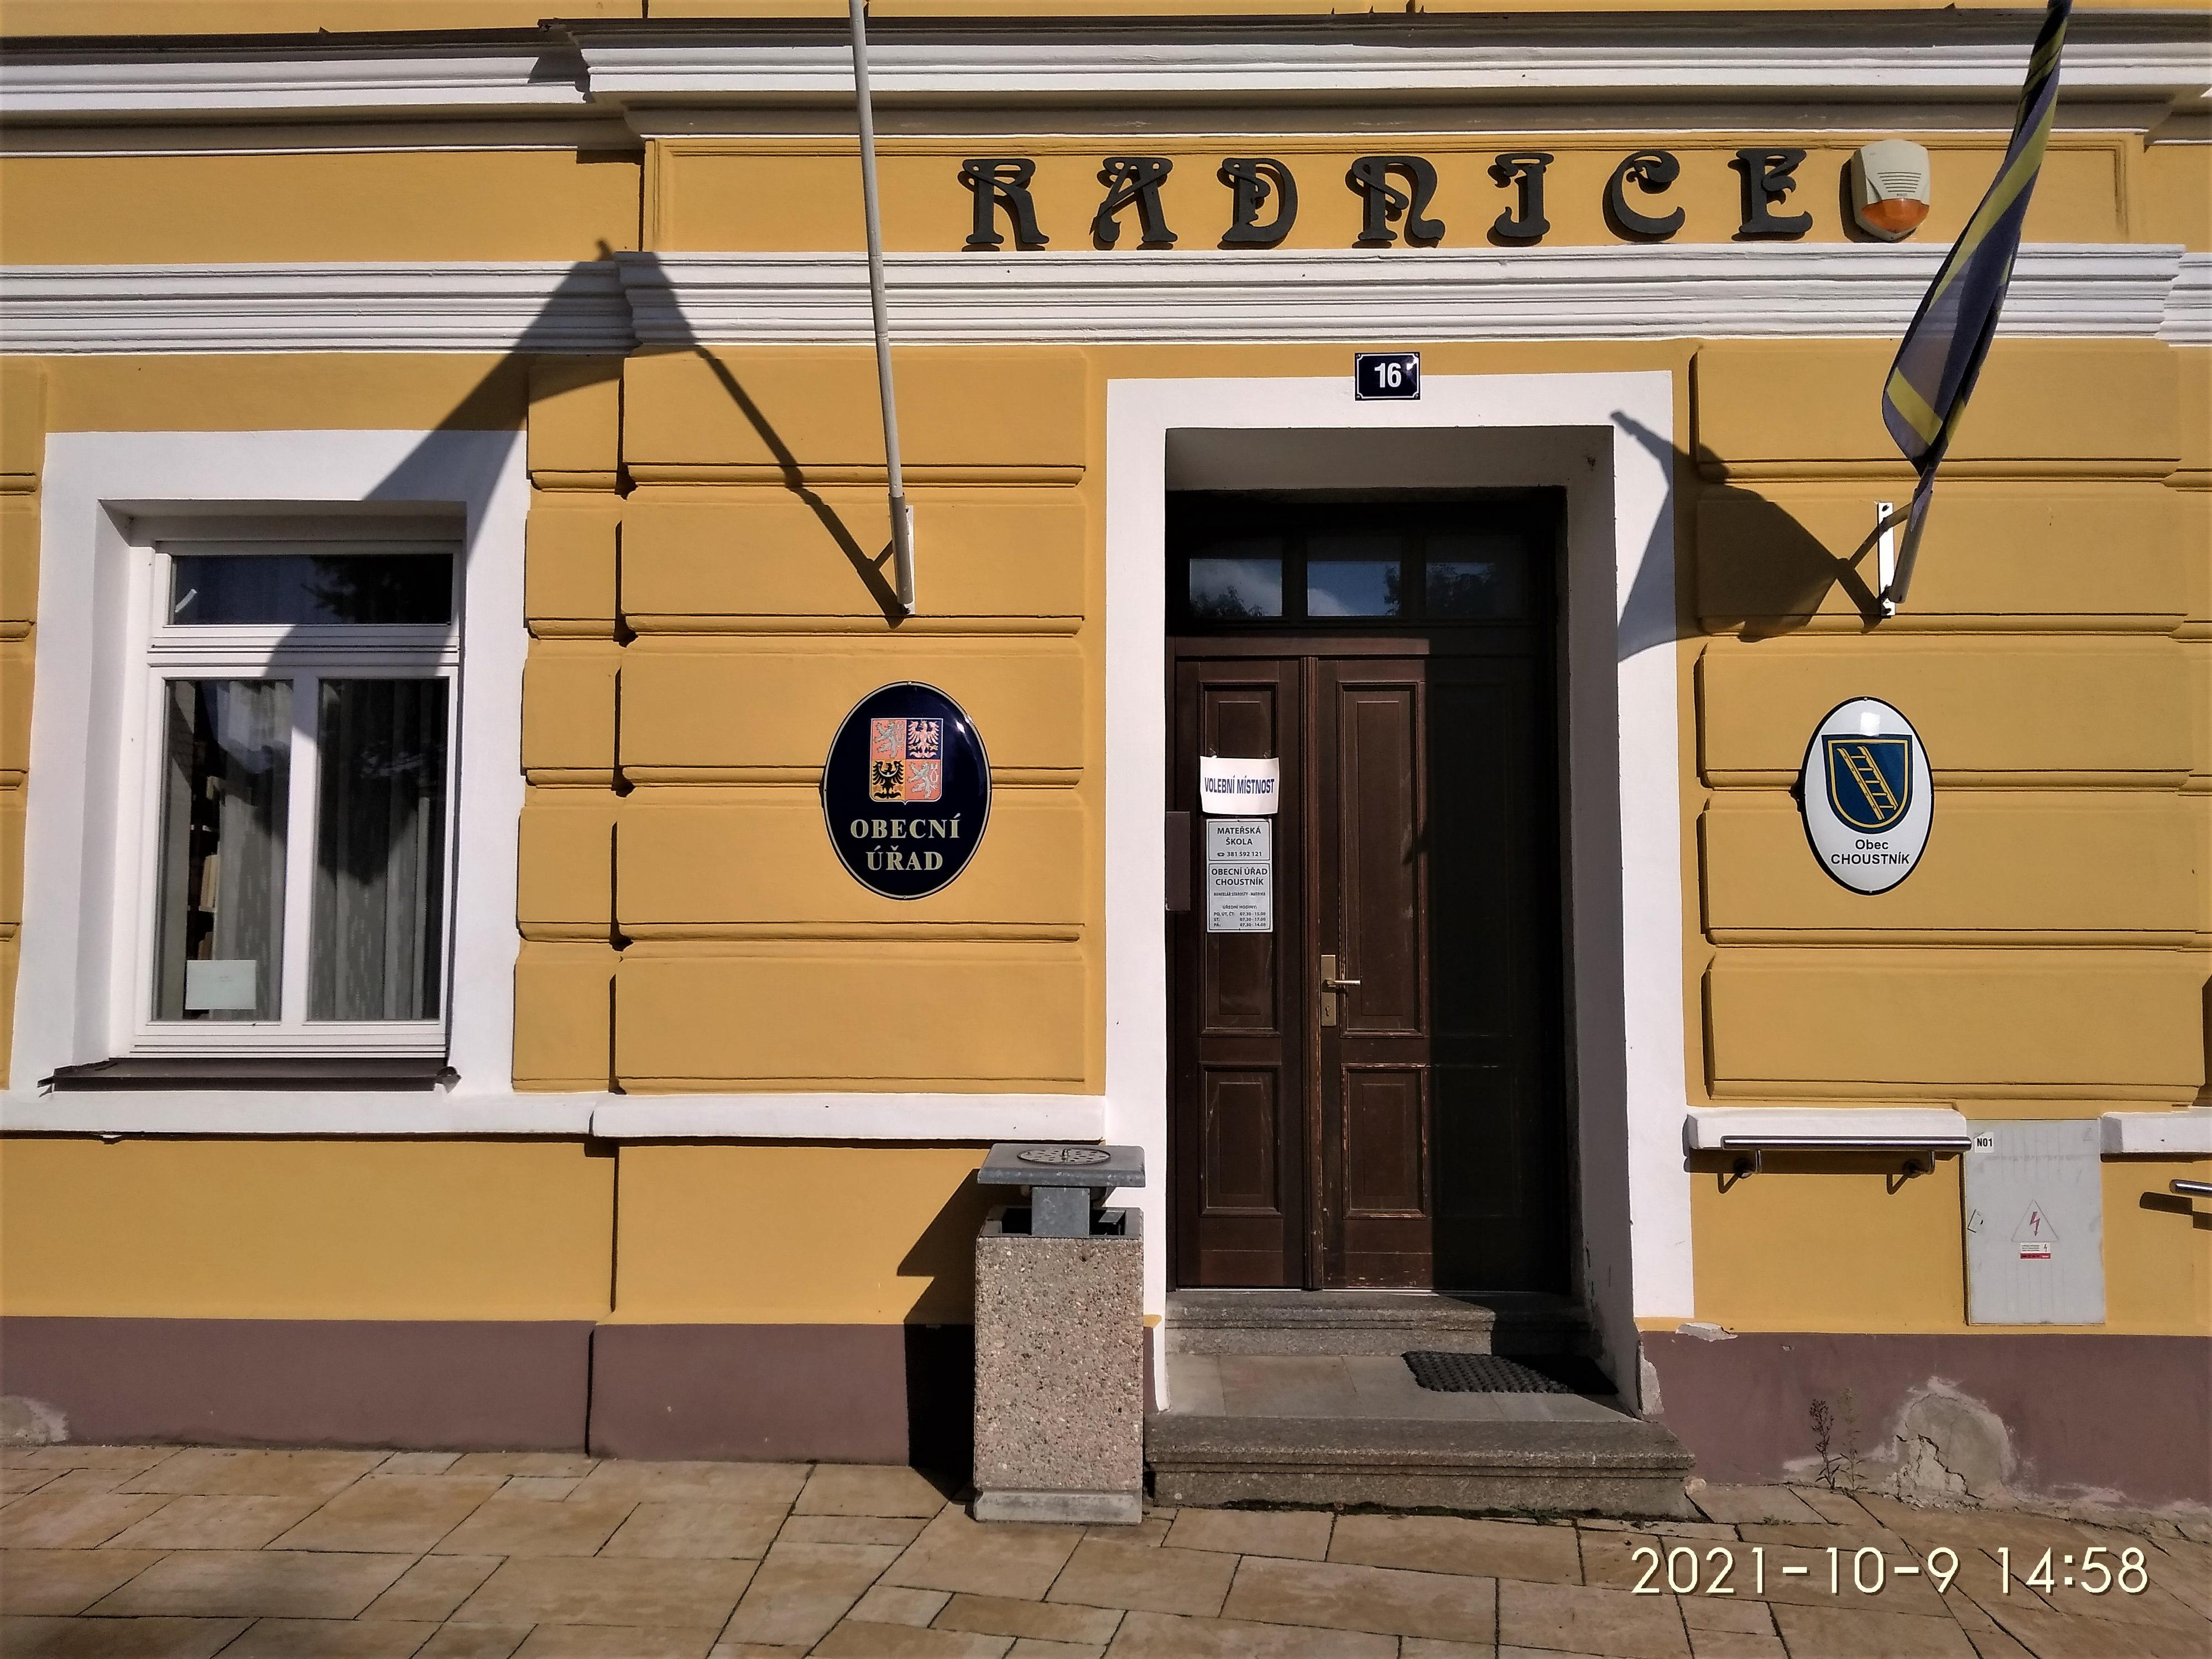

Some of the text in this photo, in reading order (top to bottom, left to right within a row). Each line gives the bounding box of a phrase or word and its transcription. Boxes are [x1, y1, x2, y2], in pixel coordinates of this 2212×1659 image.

[958, 148, 1813, 245] RADNICE
[1374, 363, 1402, 388] 16
[1204, 775, 1275, 794] VOLEBNÍ MÍSTNOST
[850, 813, 961, 839] OBECNÍ
[1225, 837, 1253, 845] ŠKOLA
[1855, 839, 1889, 850] Obec
[865, 845, 943, 870] ÚŘAD
[1830, 852, 1910, 865] CHOUSTNÍK
[1215, 877, 1264, 885] CHOUSTNÍK
